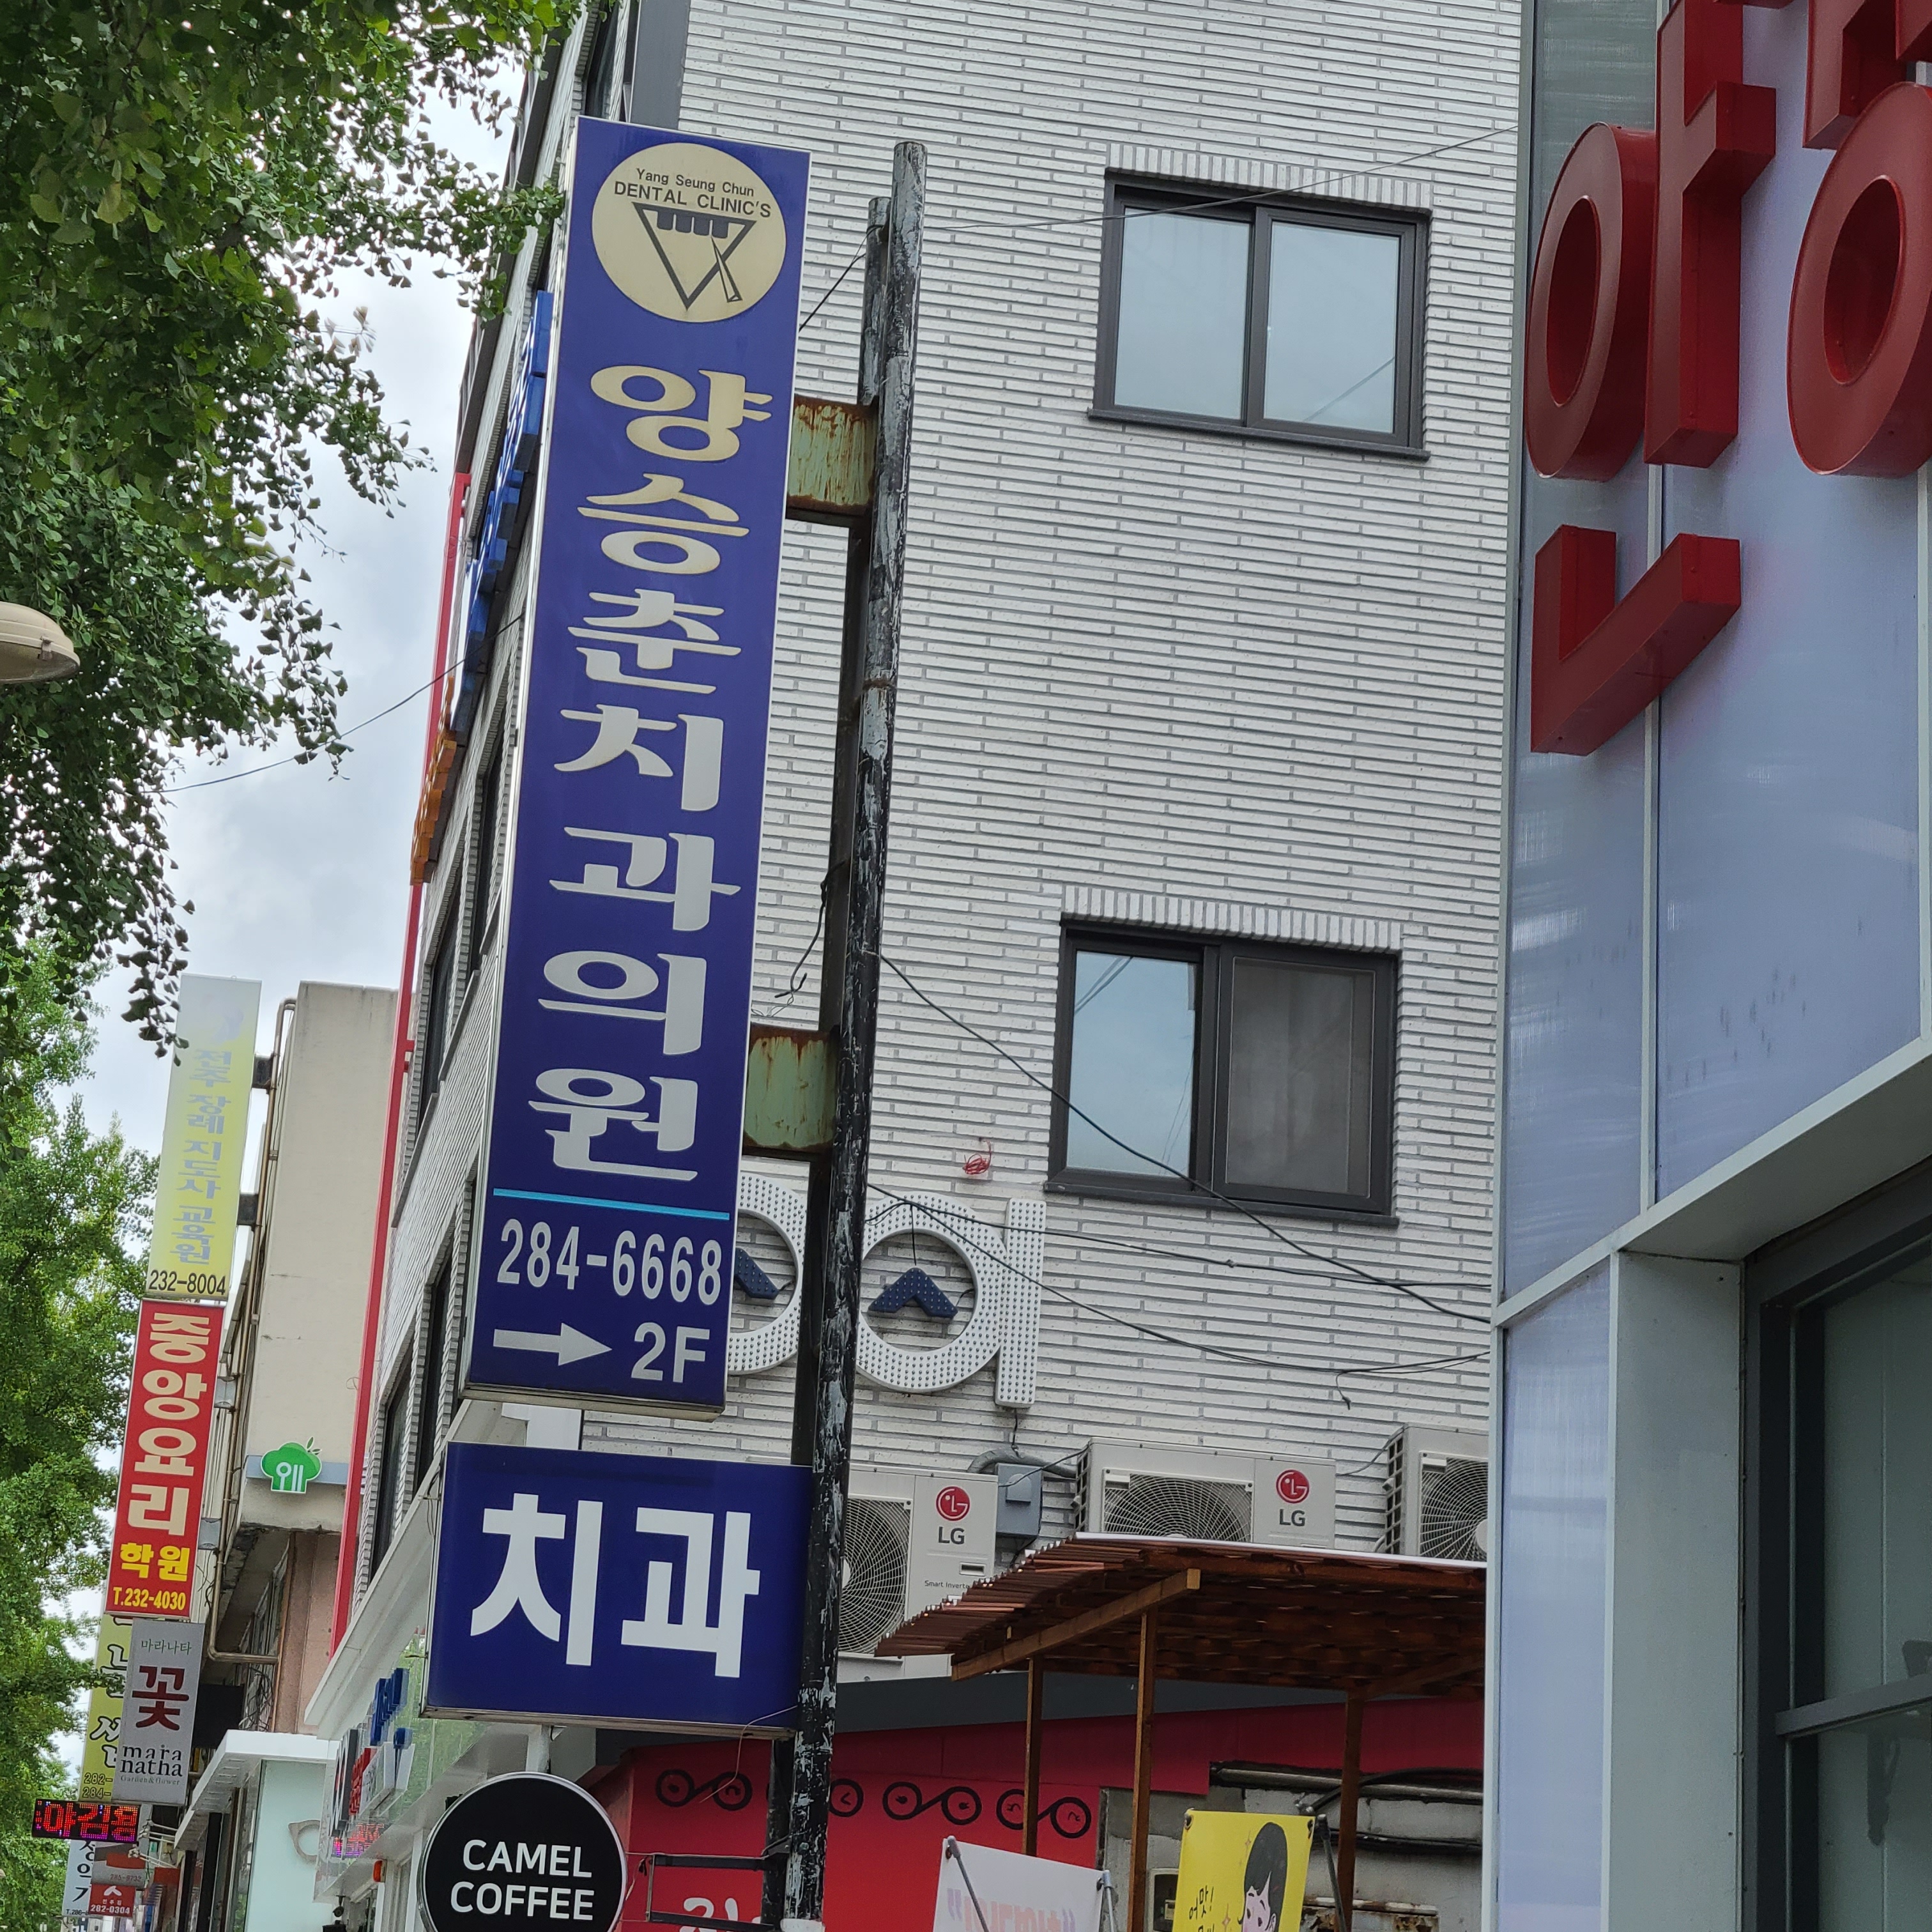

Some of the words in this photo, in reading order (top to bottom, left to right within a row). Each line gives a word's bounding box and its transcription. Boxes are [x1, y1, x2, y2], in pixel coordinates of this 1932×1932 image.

[614, 181, 687, 205] DENTAL
[697, 194, 771, 217] CLINIC'S
[636, 168, 669, 185] Yang
[676, 174, 716, 192] Seung
[723, 182, 754, 197] Chun
[496, 1218, 723, 1307] 284-6668
[148, 1269, 226, 1296] 232-8004
[631, 1321, 712, 1384] 2F
[127, 1312, 211, 1536] 중앙요리
[938, 1526, 965, 1545] LG
[1279, 1508, 1306, 1527] LG
[119, 1542, 190, 1582] 학원
[113, 1587, 186, 1611] T.232-4030
[470, 1492, 761, 1678] 치과
[141, 1638, 192, 1655] 마라나타
[132, 1665, 190, 1731] 꽃
[120, 1759, 183, 1777] natha
[462, 1839, 593, 1879] CAMEL
[90, 1904, 130, 1914] 282-0304
[450, 1881, 595, 1921] COFFEE
